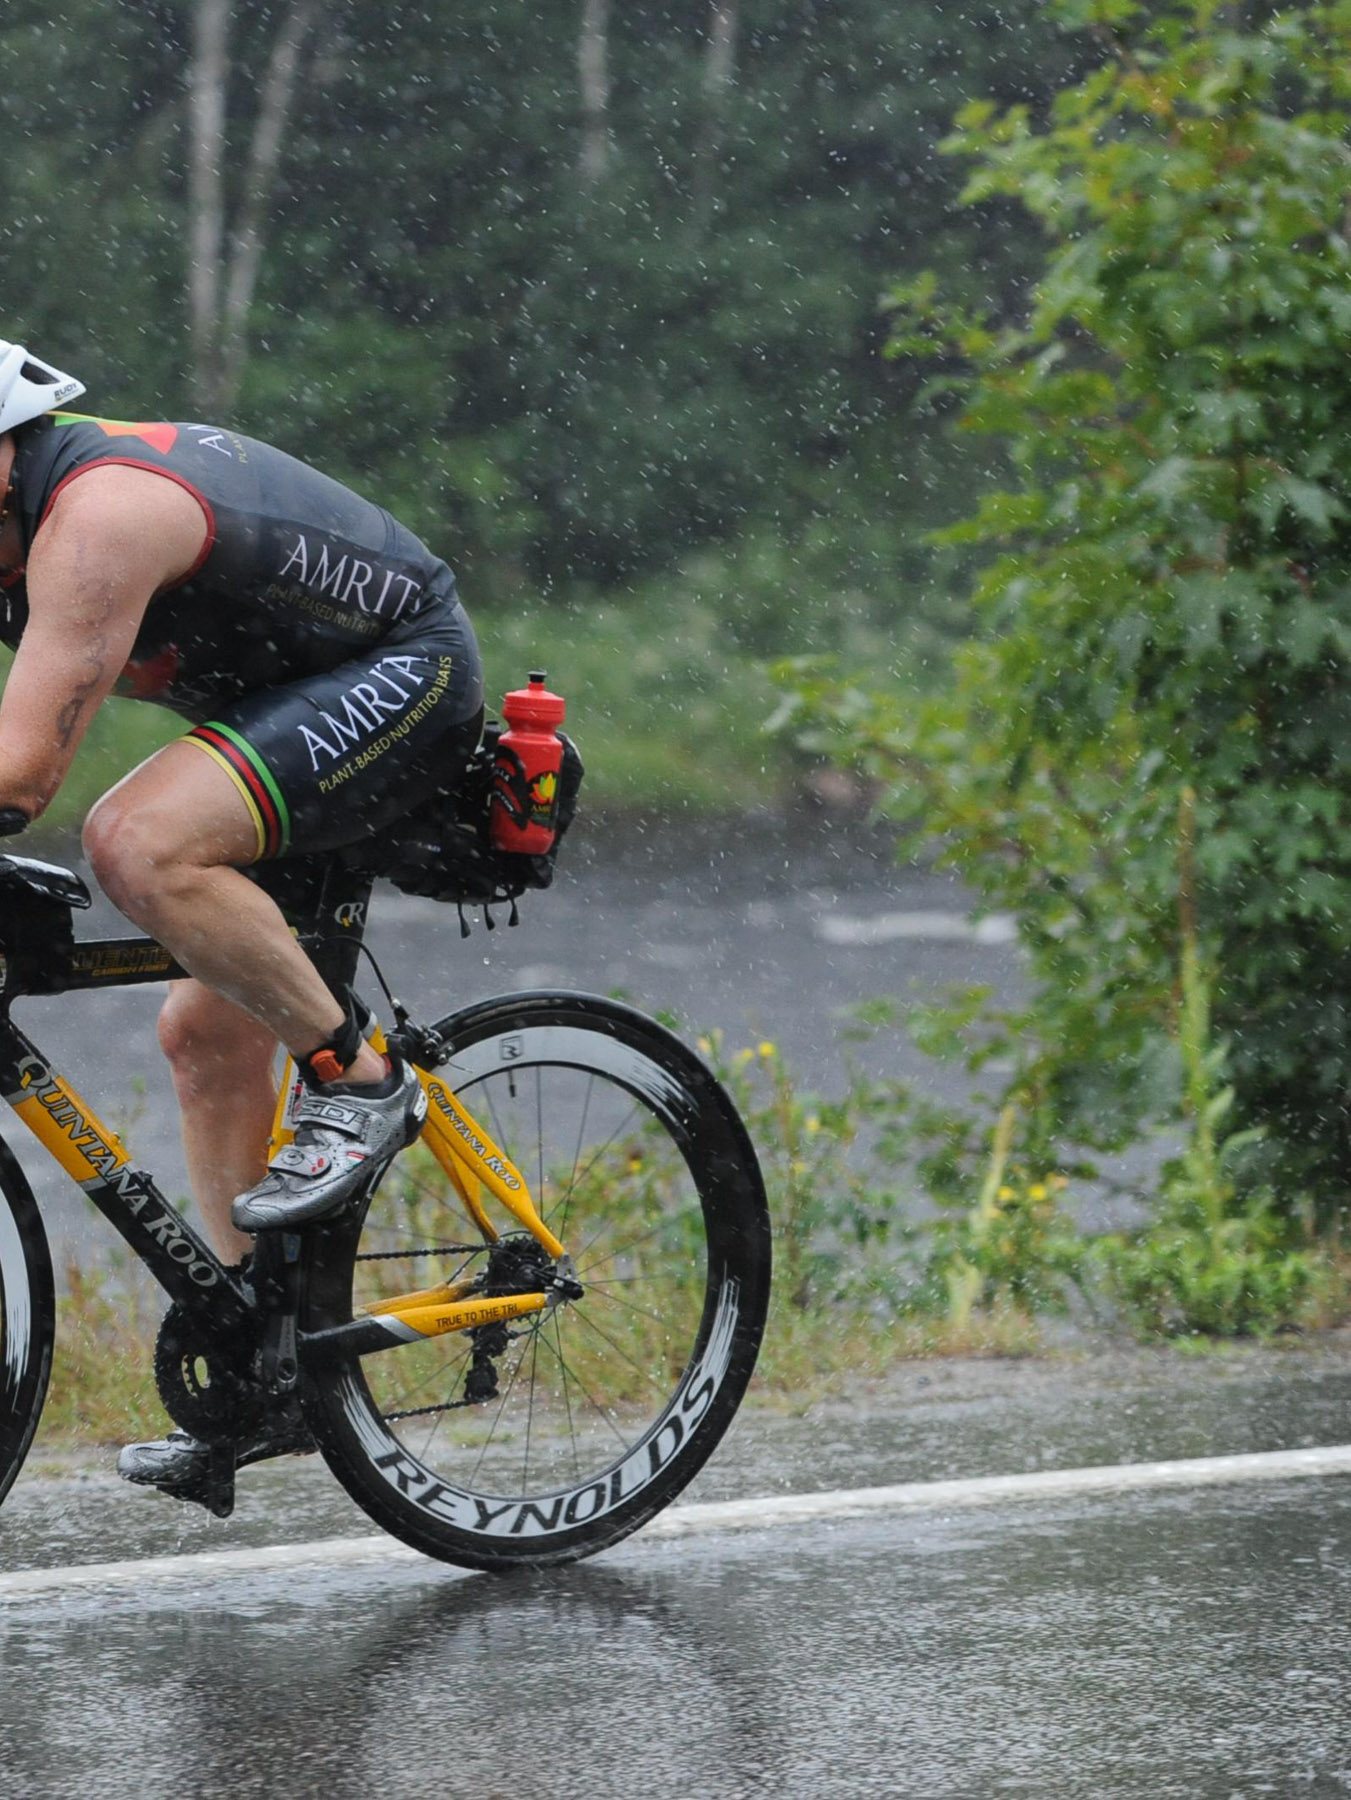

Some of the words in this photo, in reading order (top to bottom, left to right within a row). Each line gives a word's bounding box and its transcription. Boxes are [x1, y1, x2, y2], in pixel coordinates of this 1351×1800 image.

[297, 655, 429, 772] AMRIA
[318, 737, 391, 794] PLANT-BASED
[389, 686, 445, 742] NUTRITION
[14, 1056, 150, 1216] QUINTANA
[143, 1213, 218, 1287] ROO
[428, 1082, 487, 1157] QUINTANA
[483, 1155, 521, 1190] ROO
[436, 1313, 462, 1328] TRUE
[464, 1311, 478, 1322] TO
[480, 1306, 500, 1319] THE
[374, 1375, 716, 1535] REYNOLDS
